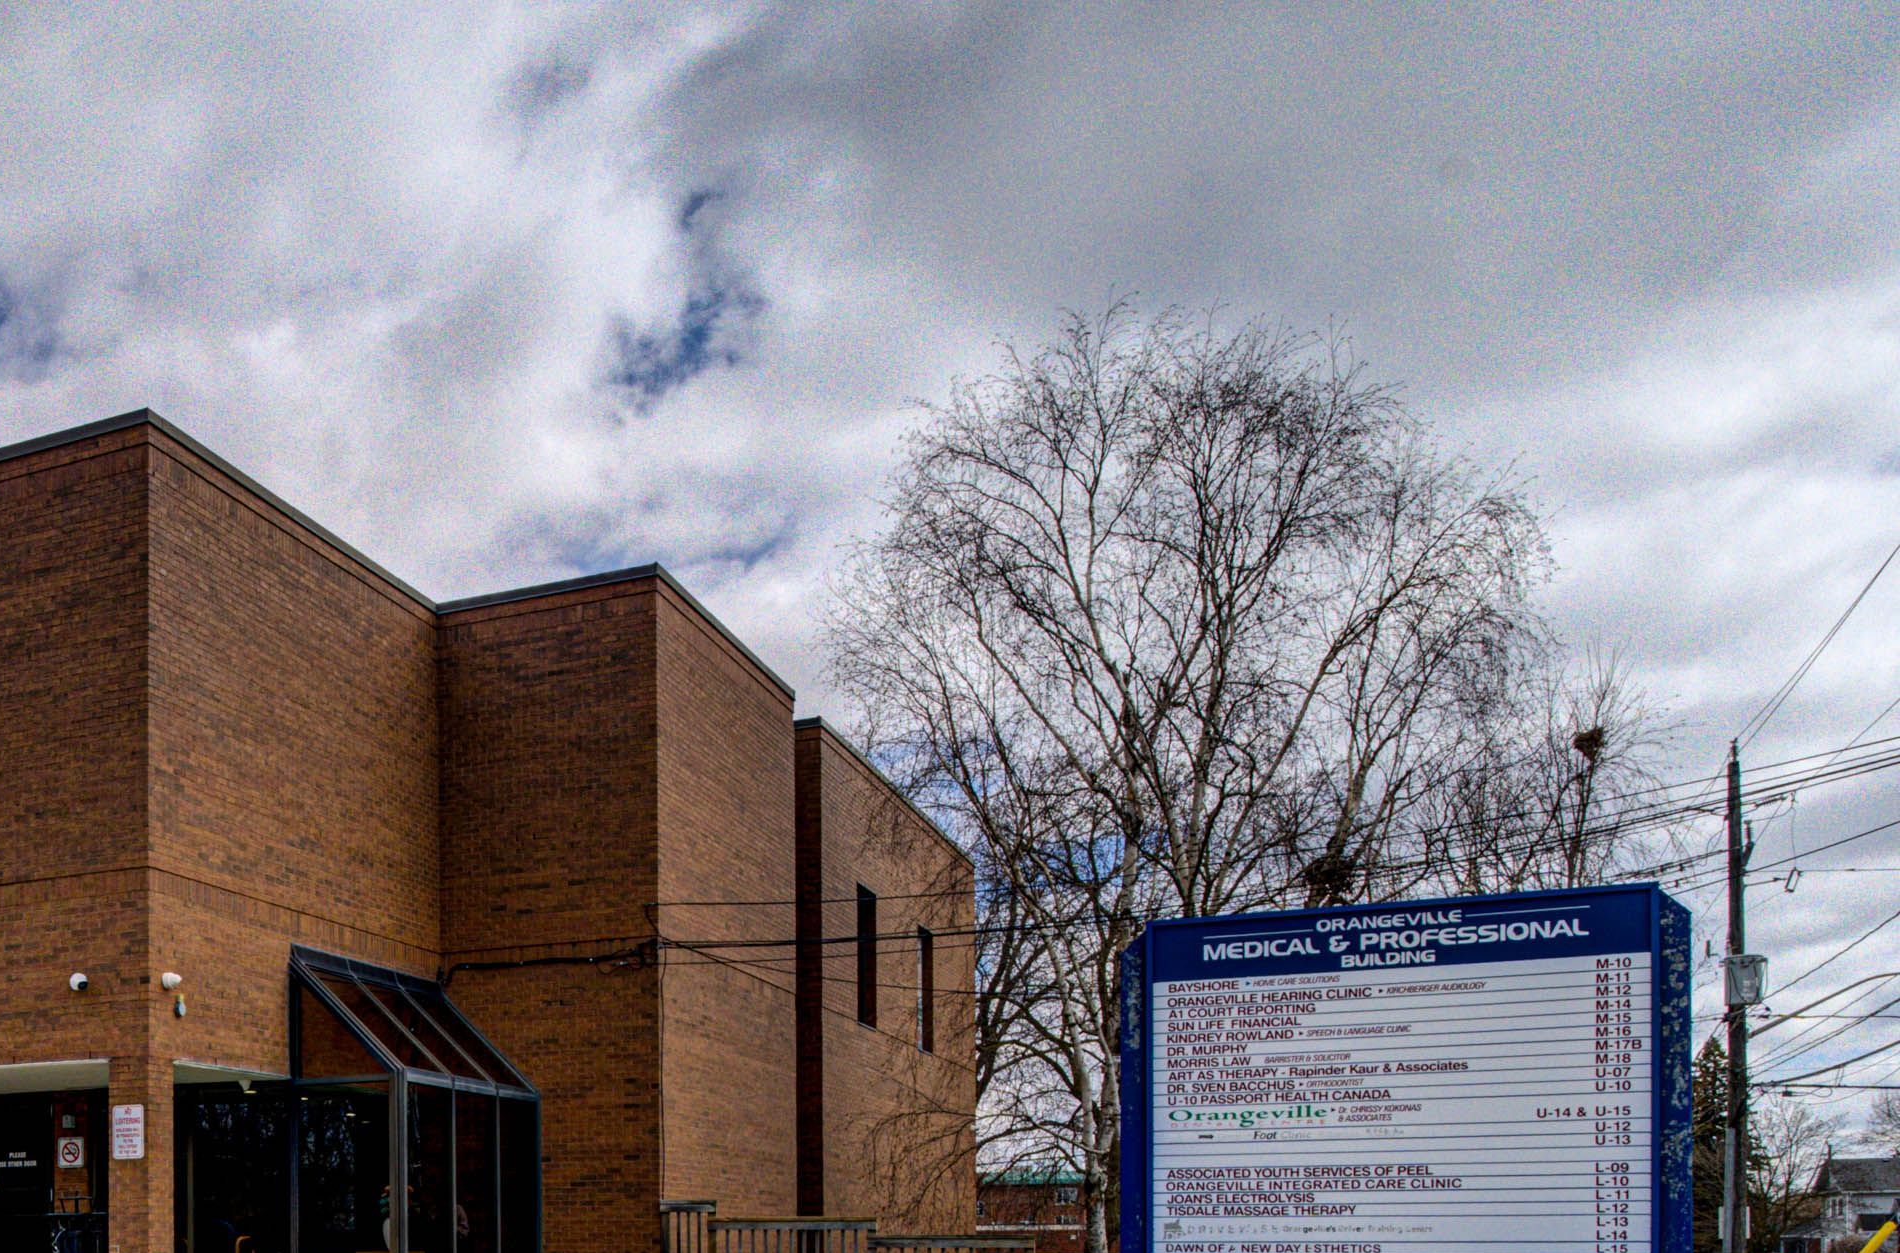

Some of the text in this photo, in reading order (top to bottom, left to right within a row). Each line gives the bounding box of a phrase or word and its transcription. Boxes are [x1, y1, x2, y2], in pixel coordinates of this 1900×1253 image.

[1316, 910, 1462, 932] ORANGEVILLE
[1203, 918, 1589, 961] MEDICAL & PROFESSIONAL
[1341, 950, 1436, 968] BUILDING
[1596, 957, 1631, 968] M-10
[1596, 972, 1630, 983] M-11
[1168, 975, 1340, 993] BAYSHORE HOME CARE SOLUTIONS
[1596, 985, 1631, 996] M-12
[1167, 994, 1258, 1008] ORANGEVILLE
[1261, 989, 1322, 1002] HEARING
[1326, 987, 1372, 999] CLINIC
[1596, 999, 1631, 1010] M-14
[1168, 1003, 1316, 1019] A1 COURT REPORTING
[1168, 1016, 1301, 1032] SUN LIFE FINANCIAL
[1596, 1013, 1631, 1024] M-15
[1166, 1033, 1222, 1043] KINDREY
[1226, 1030, 1294, 1041] ROWLAND
[1306, 1028, 1336, 1037] SPEECH
[1343, 1026, 1385, 1036] LANGUAGE
[1386, 1024, 1412, 1033] CLINIC
[1596, 1026, 1631, 1037] M-16
[1167, 1044, 1248, 1056] DR. MURPHY
[1596, 1040, 1642, 1050] M-17B
[1167, 1058, 1220, 1068] MORRIS
[1223, 1056, 1251, 1067] LAW
[1264, 1055, 1304, 1064] BARRISTER
[1312, 1053, 1350, 1062] SOLICITOR
[1596, 1054, 1631, 1064] M-18
[1169, 1072, 1194, 1081] ART
[1197, 1071, 1214, 1080] AS
[1218, 1068, 1278, 1079] THERAPY
[1289, 1066, 1346, 1077] Rapinder
[1350, 1064, 1379, 1074] Kaur
[1383, 1063, 1392, 1072] &
[1396, 1060, 1468, 1072] Associates
[1596, 1067, 1631, 1078] U-07
[1167, 1078, 1364, 1093] DR. SVEN BACCHUS ORTHODONTIST
[1200, 1093, 1271, 1105] PASSPORT
[1275, 1090, 1328, 1102] HEALTH
[1332, 1089, 1391, 1101] CANADA
[1168, 1105, 1327, 1128] Orangeville
[1350, 1105, 1382, 1113] CHRISSY
[1537, 1105, 1631, 1118] U-14 & U-15
[1345, 1113, 1392, 1122] ASSOCIATES
[1596, 1121, 1631, 1132] U-12
[1167, 1165, 1434, 1179] ASSOCIATED YOUTH SERVICES OF PEEL
[1596, 1162, 1629, 1173] L-09
[1166, 1178, 1462, 1191] ORANGEVILLE INTEGRATED CARE CLINIC
[1596, 1176, 1629, 1186] L-10
[1167, 1193, 1315, 1204] JOAN'S ELECTROLYSIS
[1166, 1205, 1356, 1216] TISDALE MASSAGE THERAPY
[1596, 1203, 1629, 1213] L-12
[1596, 1216, 1629, 1227] L-13
[1596, 1230, 1628, 1240] L-14
[1166, 1244, 1204, 1253] DAWN
[1207, 1244, 1224, 1253] OF
[1241, 1244, 1272, 1253] NEW
[1275, 1244, 1301, 1253] DAY
[1596, 1244, 1628, 1253] L-15
